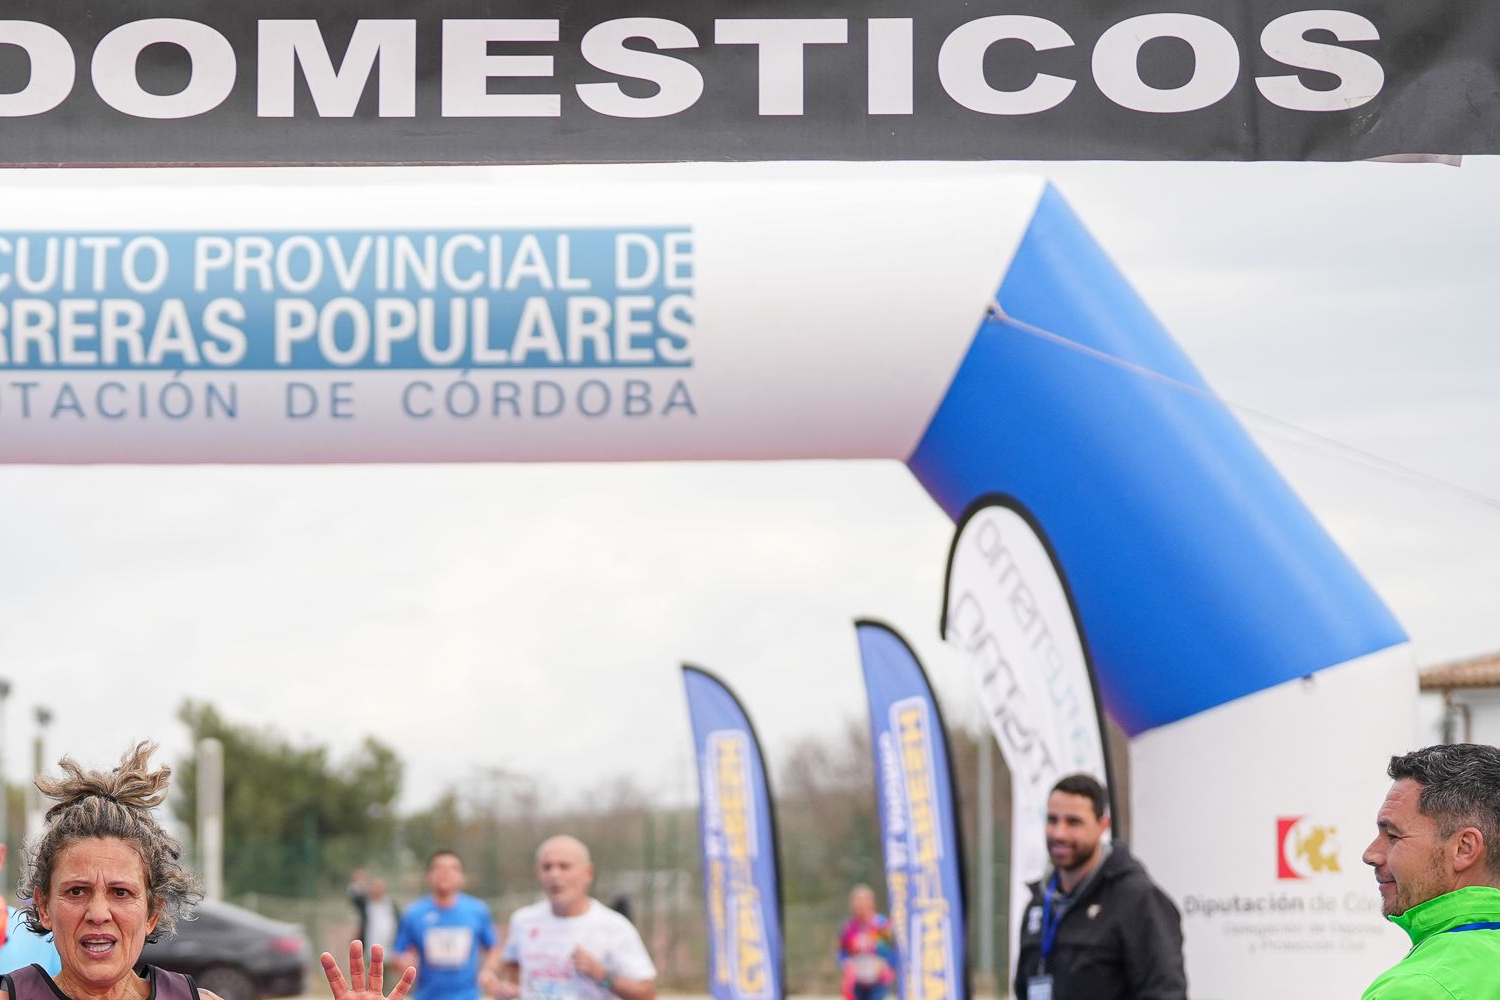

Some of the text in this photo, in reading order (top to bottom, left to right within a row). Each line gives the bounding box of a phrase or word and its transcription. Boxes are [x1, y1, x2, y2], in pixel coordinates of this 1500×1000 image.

[194, 233, 591, 292] PROVINCIAL
[615, 231, 697, 290] DE
[276, 295, 697, 364] POPULARES
[285, 382, 356, 420] DE
[400, 371, 698, 420] CÓRDOBA
